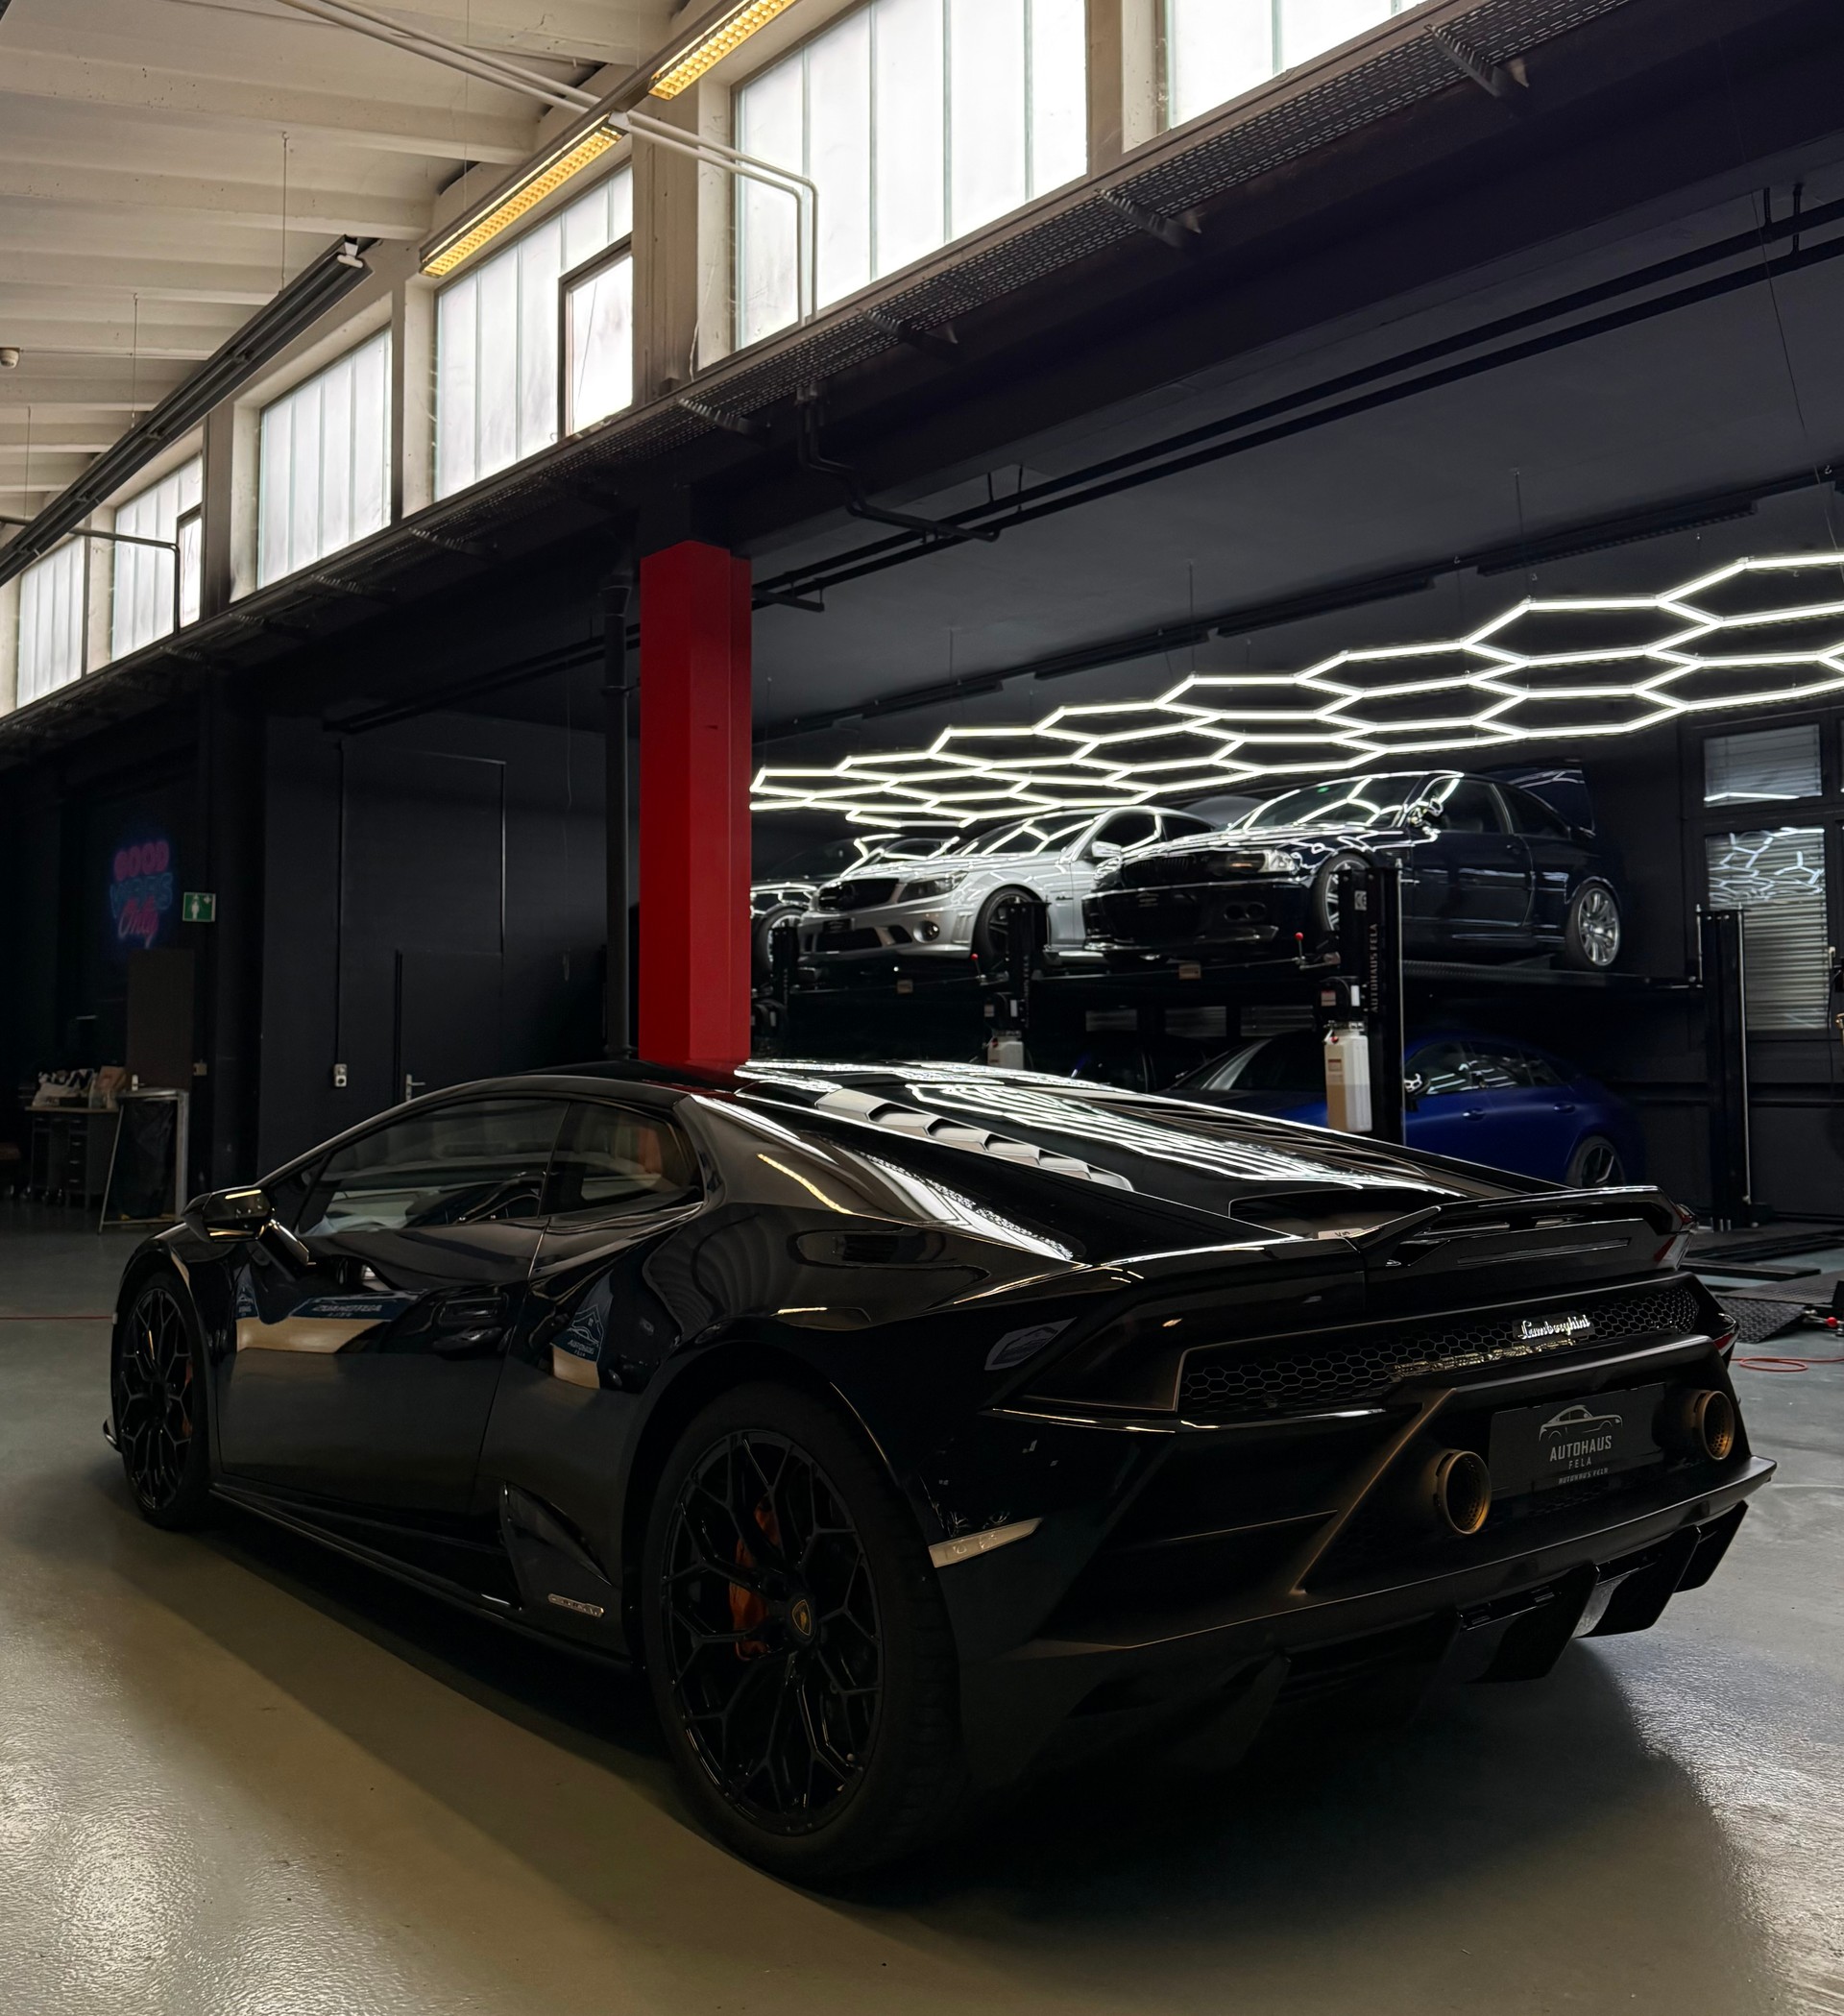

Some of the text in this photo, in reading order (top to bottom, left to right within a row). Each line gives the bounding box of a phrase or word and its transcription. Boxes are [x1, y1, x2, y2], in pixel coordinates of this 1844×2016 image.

[112, 838, 170, 883] GOOD
[1369, 923, 1379, 1014] AUTOHAUS FELA
[1516, 1314, 1591, 1340] Lamborghini
[1549, 1435, 1613, 1462] AUTOHAUS
[1568, 1456, 1591, 1469] FELA
